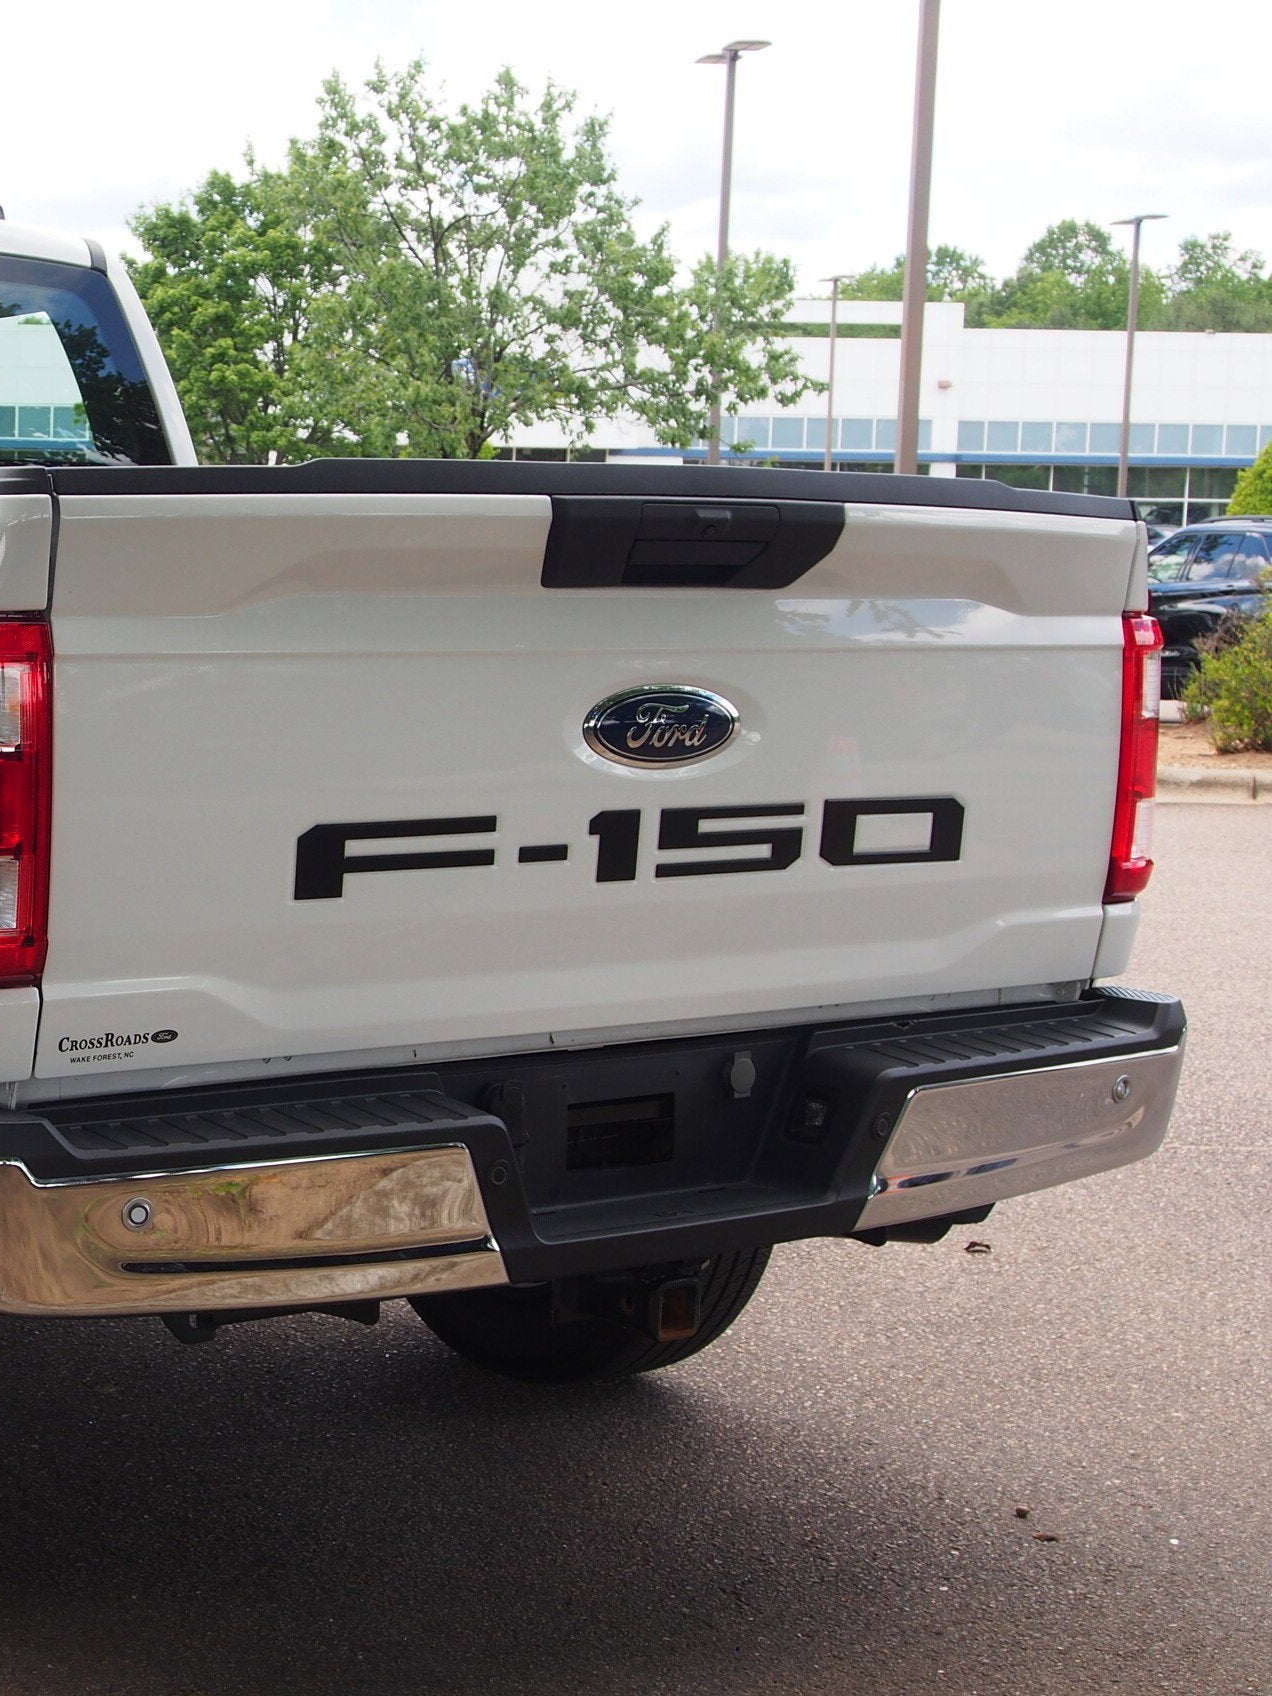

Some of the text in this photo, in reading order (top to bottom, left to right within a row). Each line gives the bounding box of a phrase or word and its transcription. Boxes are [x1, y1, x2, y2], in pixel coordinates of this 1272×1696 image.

[627, 702, 710, 750] Ford
[294, 796, 965, 900] F-150
[70, 1051, 135, 1064] WAKE FOREST, NC
